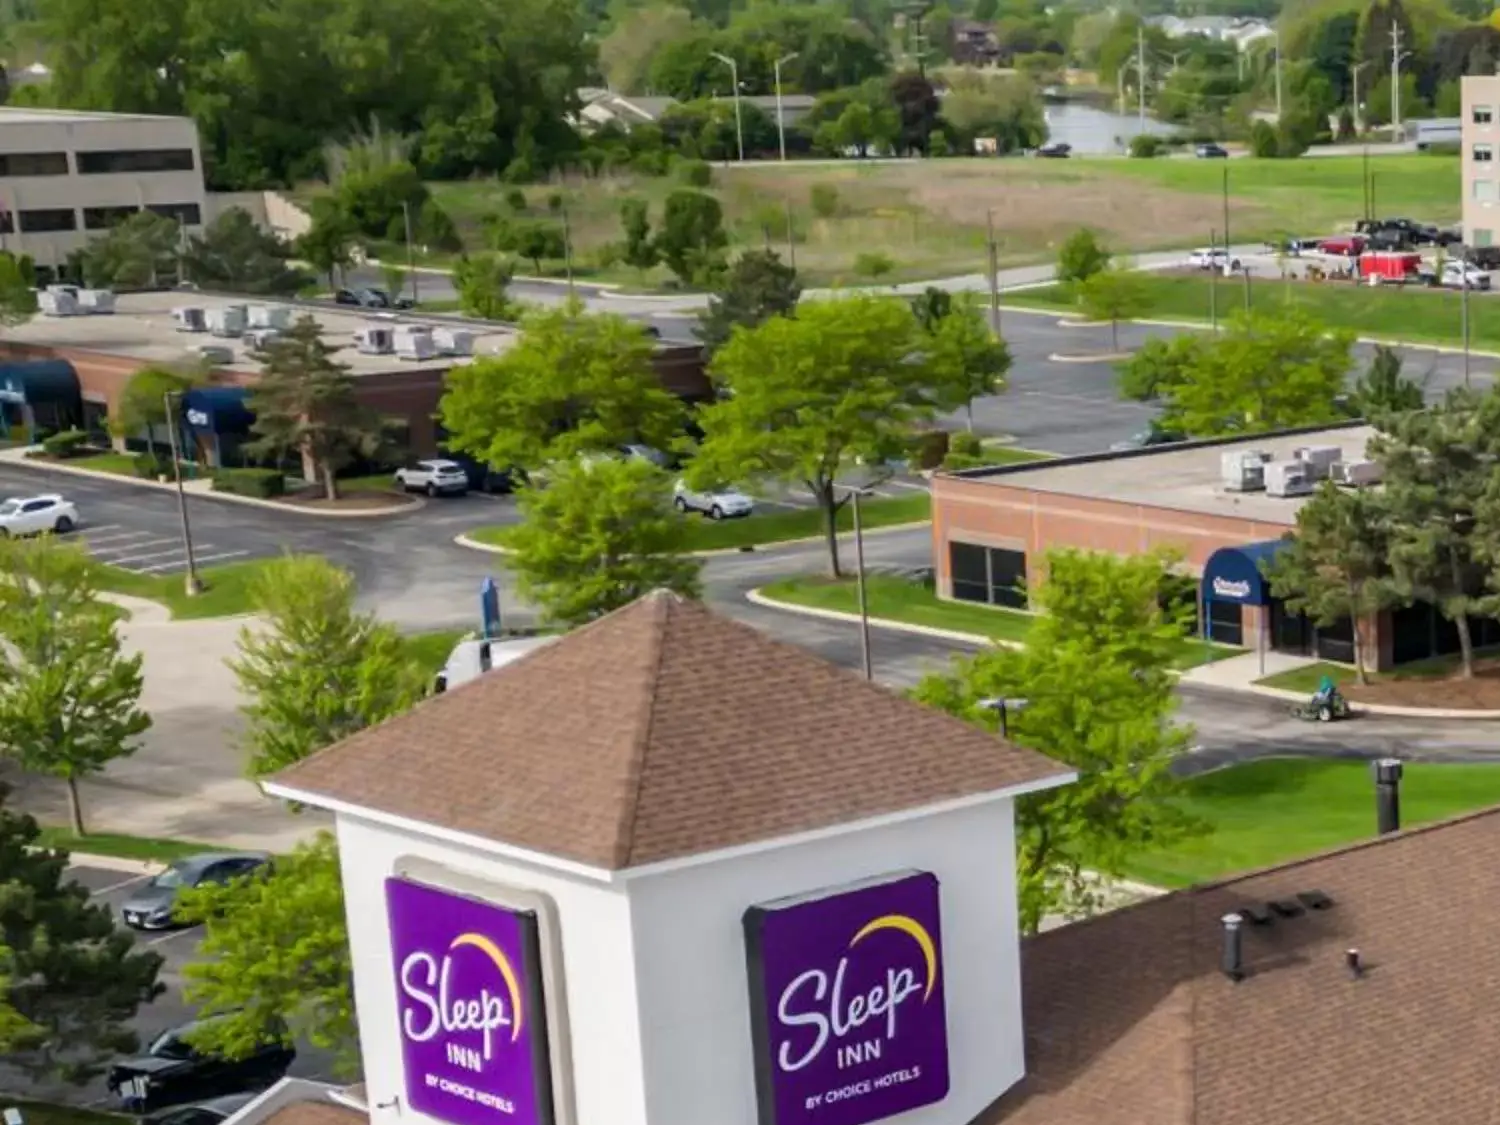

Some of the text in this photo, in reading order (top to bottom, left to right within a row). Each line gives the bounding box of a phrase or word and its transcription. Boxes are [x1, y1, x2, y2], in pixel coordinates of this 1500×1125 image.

[402, 952, 511, 1060] Sleep
[778, 957, 922, 1071] Sleep
[447, 1042, 481, 1072] INN
[837, 1039, 881, 1070] INN
[425, 1073, 515, 1114] BY CHOICE HOTELS
[805, 1065, 921, 1109] BY CHOICE HOTELS
